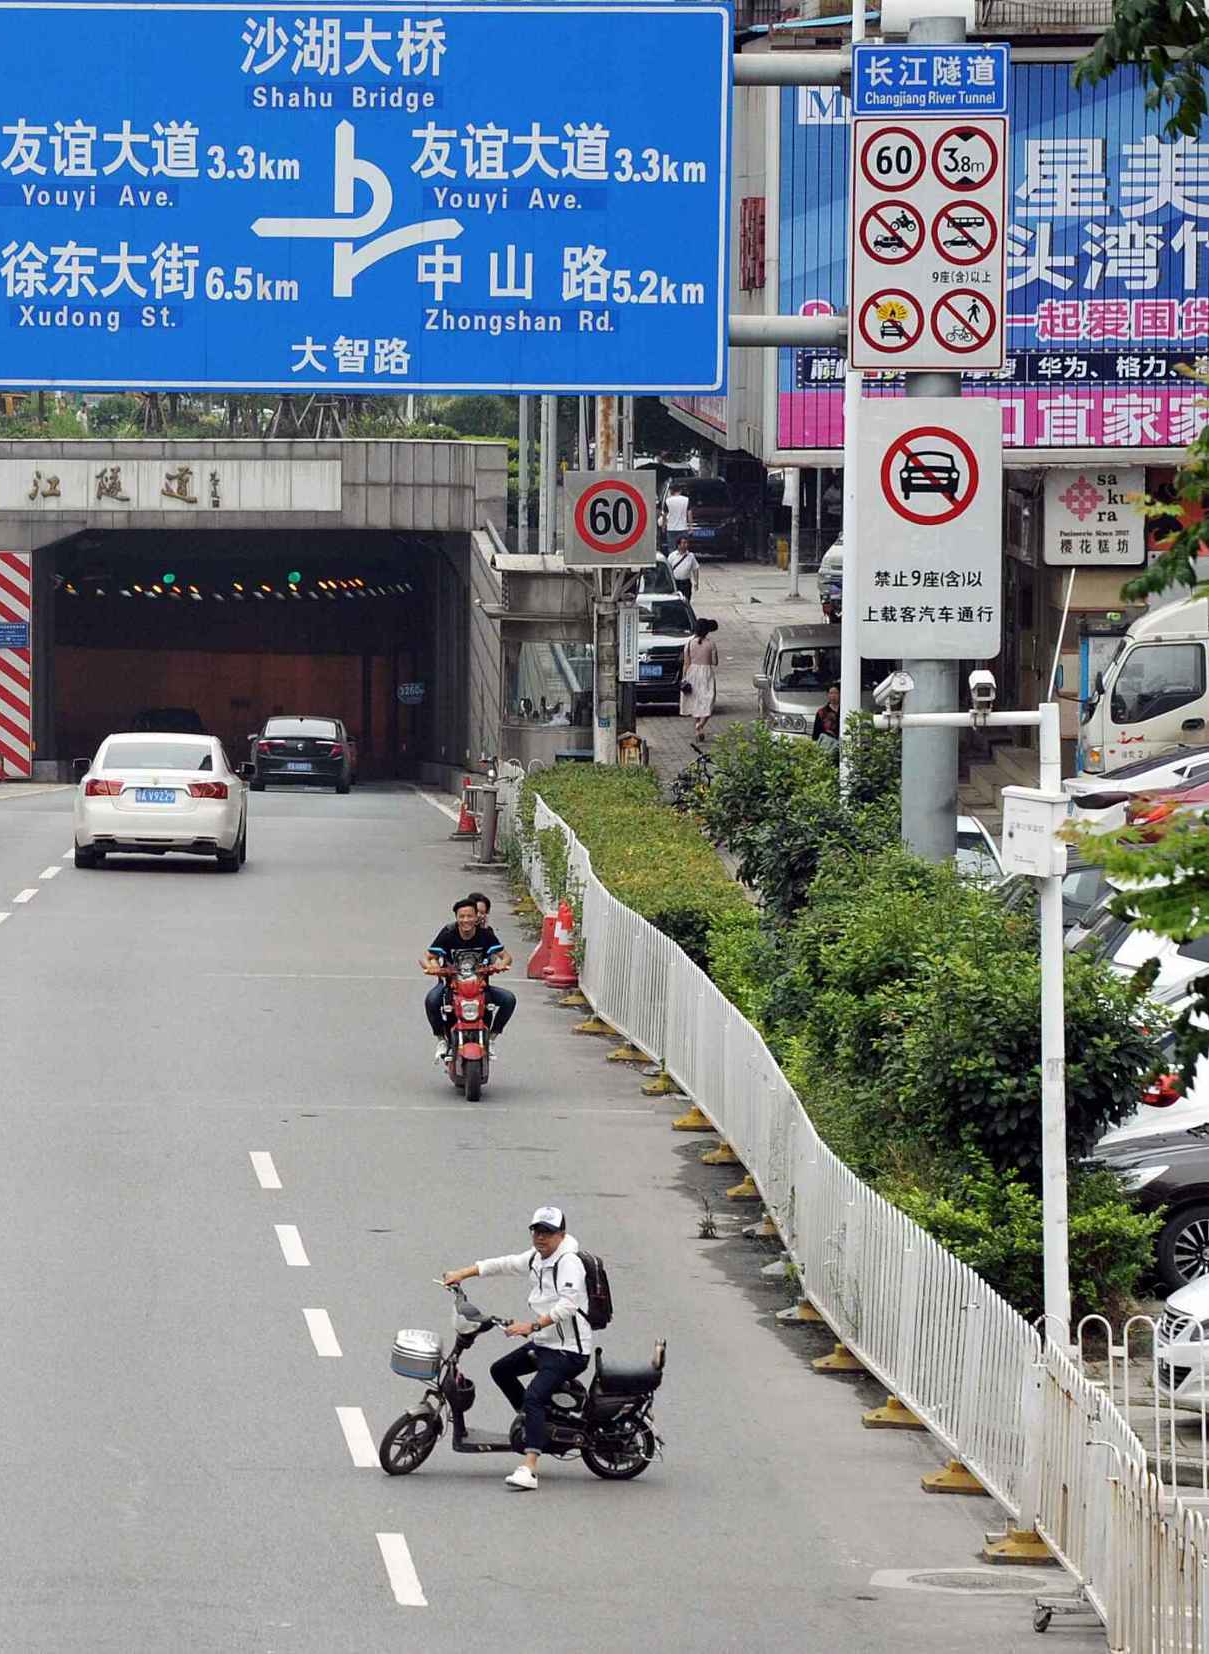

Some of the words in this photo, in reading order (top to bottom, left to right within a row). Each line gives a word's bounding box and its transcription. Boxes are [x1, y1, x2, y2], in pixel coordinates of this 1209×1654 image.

[241, 17, 447, 76] 沙湖大桥
[865, 55, 996, 87] 长江隧道
[253, 86, 332, 108] Shahu
[352, 86, 435, 113] Bridge
[865, 92, 926, 107] Changjiang
[928, 92, 956, 105] River
[958, 91, 996, 104] Tunnel
[1, 117, 200, 178] 友谊大道
[207, 145, 300, 180] 3.3km
[410, 121, 610, 180] 友谊大道
[614, 149, 706, 183] 3.3km
[876, 146, 912, 174] 60
[943, 148, 985, 173] 3.8m
[22, 184, 96, 211] Youyi
[119, 185, 173, 206] Ave.
[433, 187, 508, 214] Youyi
[529, 188, 582, 209] Ave.
[0, 240, 200, 300] 徐东大街
[206, 267, 299, 301] 6.5km
[418, 246, 610, 302] 中山路
[613, 270, 704, 304] 5.2km
[932, 271, 991, 283] 9座(含)以上
[19, 305, 120, 332] Xudong
[141, 306, 176, 327] St.
[425, 308, 561, 334] Zhongshan
[579, 310, 614, 331] Rd.
[291, 335, 411, 375] 大智路
[1097, 474, 1118, 486] sa
[590, 497, 634, 536] 60
[1097, 510, 1118, 522] ra
[874, 570, 982, 588] 禁止9座(含)以
[862, 605, 994, 623] 上载客汽车通行
